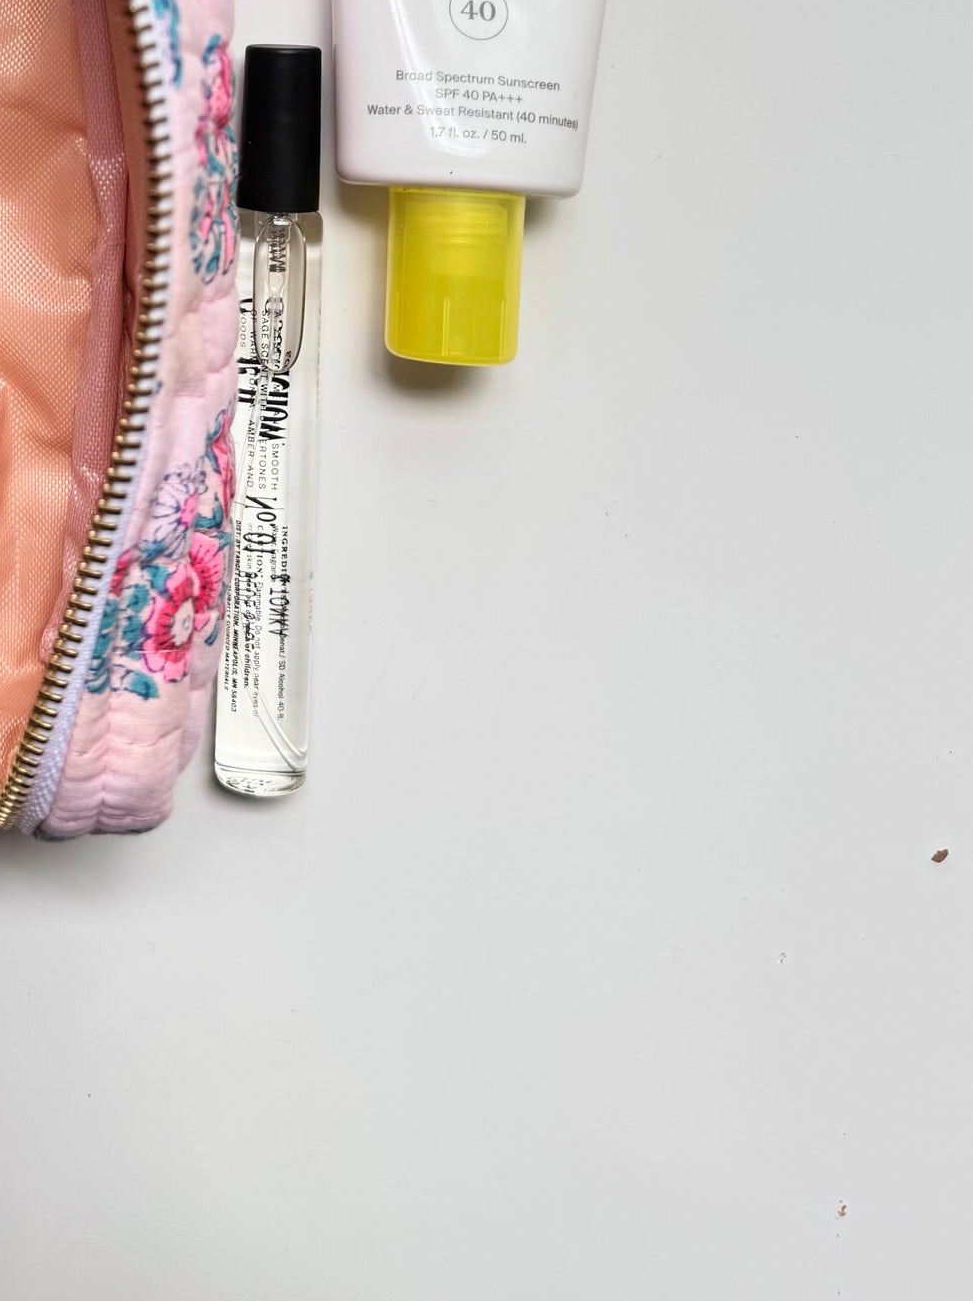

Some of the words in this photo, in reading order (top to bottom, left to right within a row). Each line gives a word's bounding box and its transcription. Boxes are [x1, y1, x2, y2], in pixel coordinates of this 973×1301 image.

[460, 0, 496, 21] 40
[396, 70, 432, 81] Broad
[436, 71, 495, 86] Spectrum
[497, 75, 561, 91] Sunscreen
[435, 88, 460, 99] SPF
[462, 89, 479, 100] 40
[482, 90, 524, 103] PA+++
[367, 104, 400, 116] Water
[403, 104, 413, 115] &
[416, 104, 455, 117] Sweat
[458, 106, 514, 121] Resistant
[516, 110, 536, 124] (40
[538, 114, 579, 131] minutes)
[429, 126, 445, 138] 1.7
[463, 129, 480, 139] oz.
[491, 129, 507, 141] 50
[510, 131, 527, 144] ml.
[260, 310, 271, 339] SAGE
[258, 342, 270, 379] SCENT
[258, 383, 268, 410] WITH
[245, 419, 256, 457] AMBER
[246, 464, 254, 488] AND
[268, 443, 281, 490] SMOOTH
[233, 549, 241, 576] TARGET
[254, 625, 261, 634] Do
[229, 628, 240, 675] MINNEAPOLIS,
[253, 636, 261, 649] not
[242, 653, 251, 688] children.
[251, 650, 261, 671] apply
[278, 660, 286, 670] SD
[231, 677, 237, 688] MN
[276, 672, 285, 698] Alcohol
[229, 690, 237, 712] 55403
[250, 691, 259, 707] eyes
